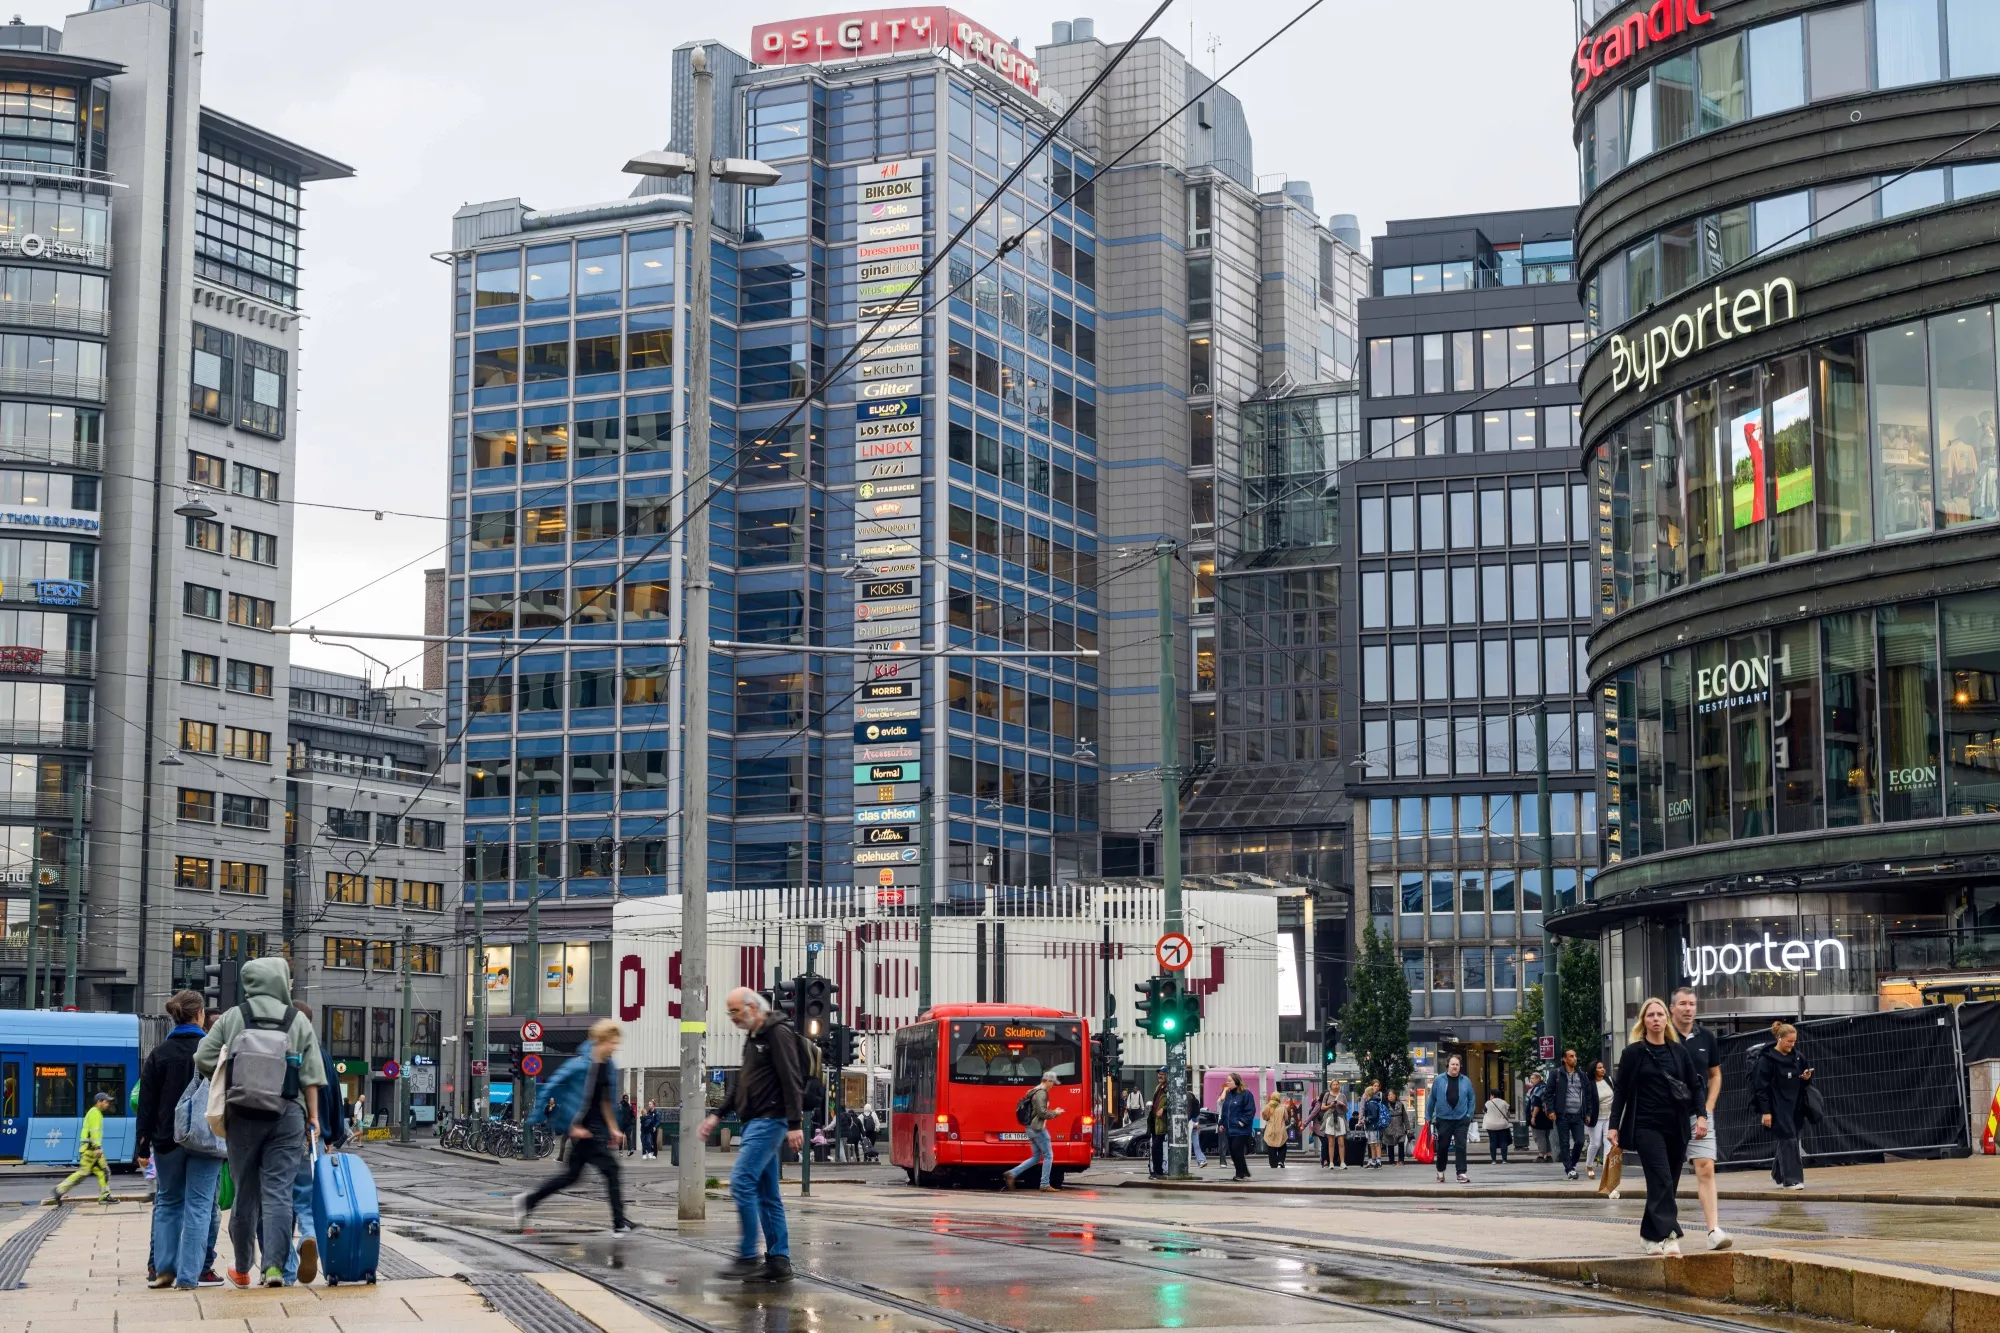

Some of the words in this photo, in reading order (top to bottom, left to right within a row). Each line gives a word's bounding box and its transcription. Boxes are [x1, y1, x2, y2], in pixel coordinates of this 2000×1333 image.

[1578, 0, 1712, 92] Scandic
[866, 186, 886, 198] BIK
[887, 182, 912, 196] BOK
[887, 204, 908, 214] Telia
[870, 222, 910, 236] KappAhl
[54, 240, 94, 258] Steen
[860, 242, 920, 258] Dressmann
[1610, 277, 1795, 392] Byporten
[864, 383, 913, 397] Glitter
[860, 424, 880, 437] LOS
[882, 421, 915, 434] TACOS
[876, 484, 915, 494] STARBUCKS
[8, 512, 40, 525] THON
[44, 516, 98, 530] GRUPPEN
[889, 564, 916, 572] JONES
[31, 580, 88, 598] THON
[870, 584, 904, 596] KICKS
[874, 663, 898, 677] Kid
[1698, 655, 1770, 701] EGON
[872, 686, 902, 696] MORRIS
[1700, 692, 1768, 714] RESTAURANT
[881, 726, 907, 736] evidia
[874, 768, 900, 779] Normal
[1889, 766, 1936, 785] EGON
[1890, 782, 1938, 792] RESTAURANT
[858, 809, 880, 821] clas
[881, 806, 916, 820] ohlson
[1668, 799, 1692, 816] EGON
[856, 851, 899, 864] eplehuset
[984, 1026, 996, 1038] 70
[1004, 1027, 1046, 1038] Skullerud
[36, 1066, 40, 1076] 7
